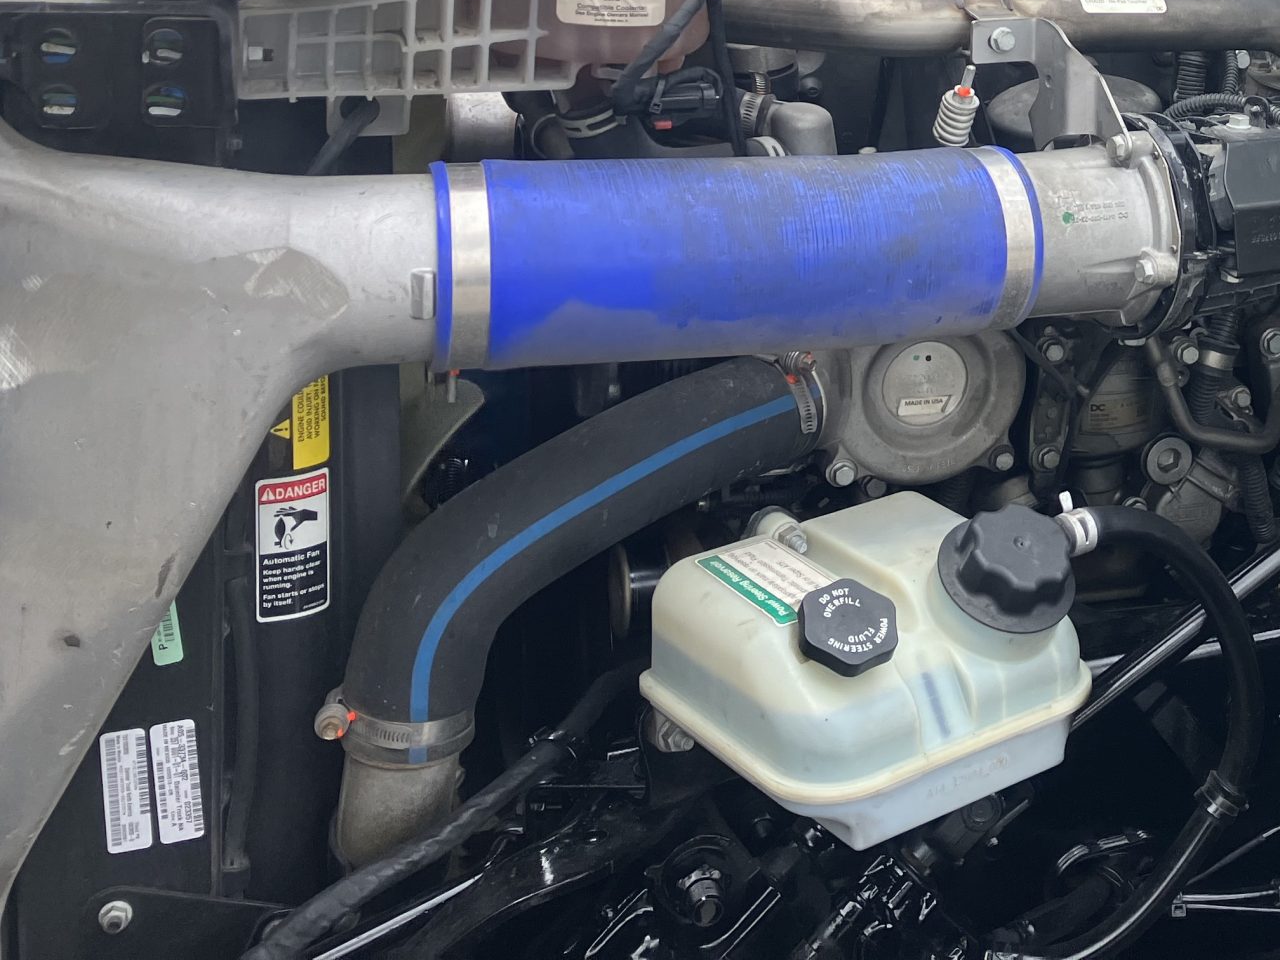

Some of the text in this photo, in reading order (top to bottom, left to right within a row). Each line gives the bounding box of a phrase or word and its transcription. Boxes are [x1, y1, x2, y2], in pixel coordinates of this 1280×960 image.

[1090, 404, 1106, 412] DC
[275, 478, 326, 500] DANGER
[263, 550, 320, 566] Automatic Fan
[283, 565, 304, 573] hands
[306, 560, 321, 568] clear
[283, 572, 307, 580] engine
[308, 583, 325, 592] stops
[740, 580, 769, 601] Steering
[819, 588, 850, 605] DO NOT
[765, 599, 790, 617] Power
[823, 597, 861, 618] OVERFILL
[827, 618, 888, 653] POWER STEERING
[848, 627, 876, 643] FLUID
